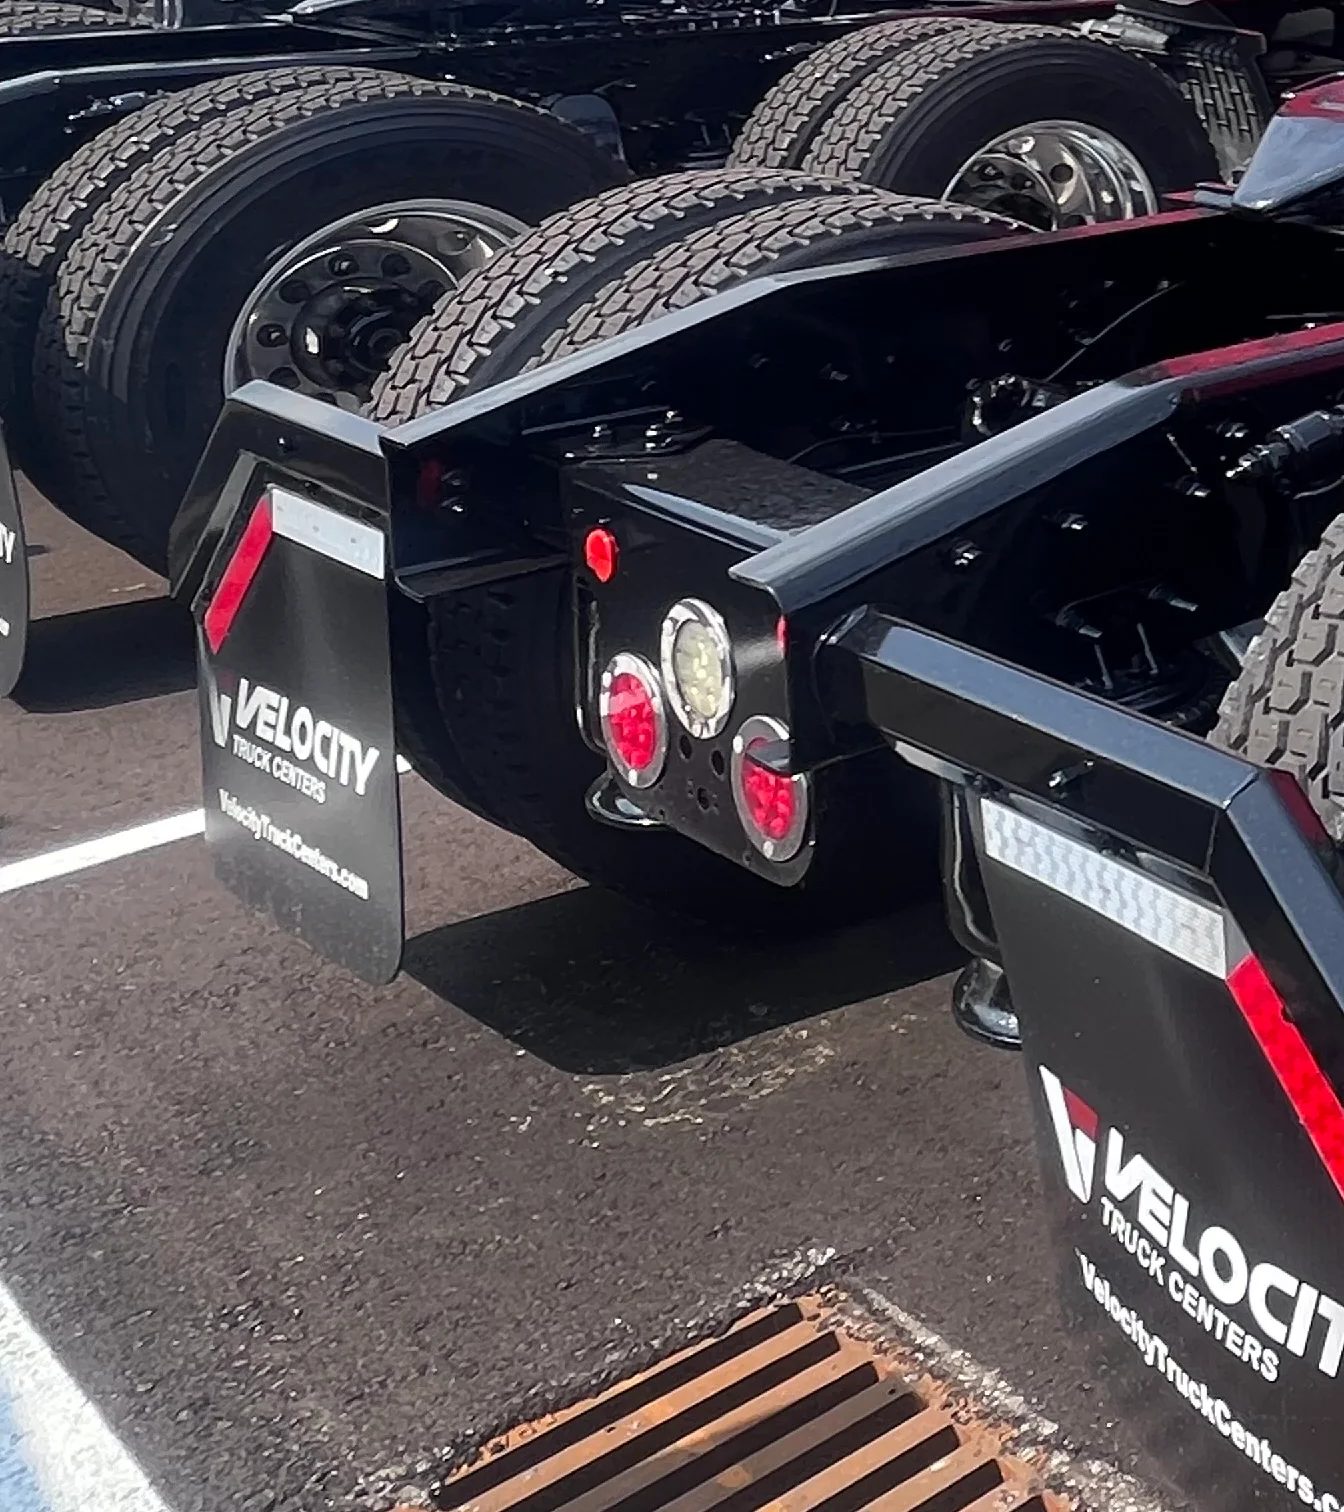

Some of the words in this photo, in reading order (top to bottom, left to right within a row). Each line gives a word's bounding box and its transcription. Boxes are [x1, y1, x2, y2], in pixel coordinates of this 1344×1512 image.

[233, 734, 273, 774] TRUCK
[272, 756, 326, 804] CENTERS
[236, 678, 380, 796] VELOCITY
[219, 789, 369, 901] VelocityTruckCenters.com
[1101, 1196, 1166, 1287] TRUCK
[1169, 1271, 1281, 1383] CENTERS
